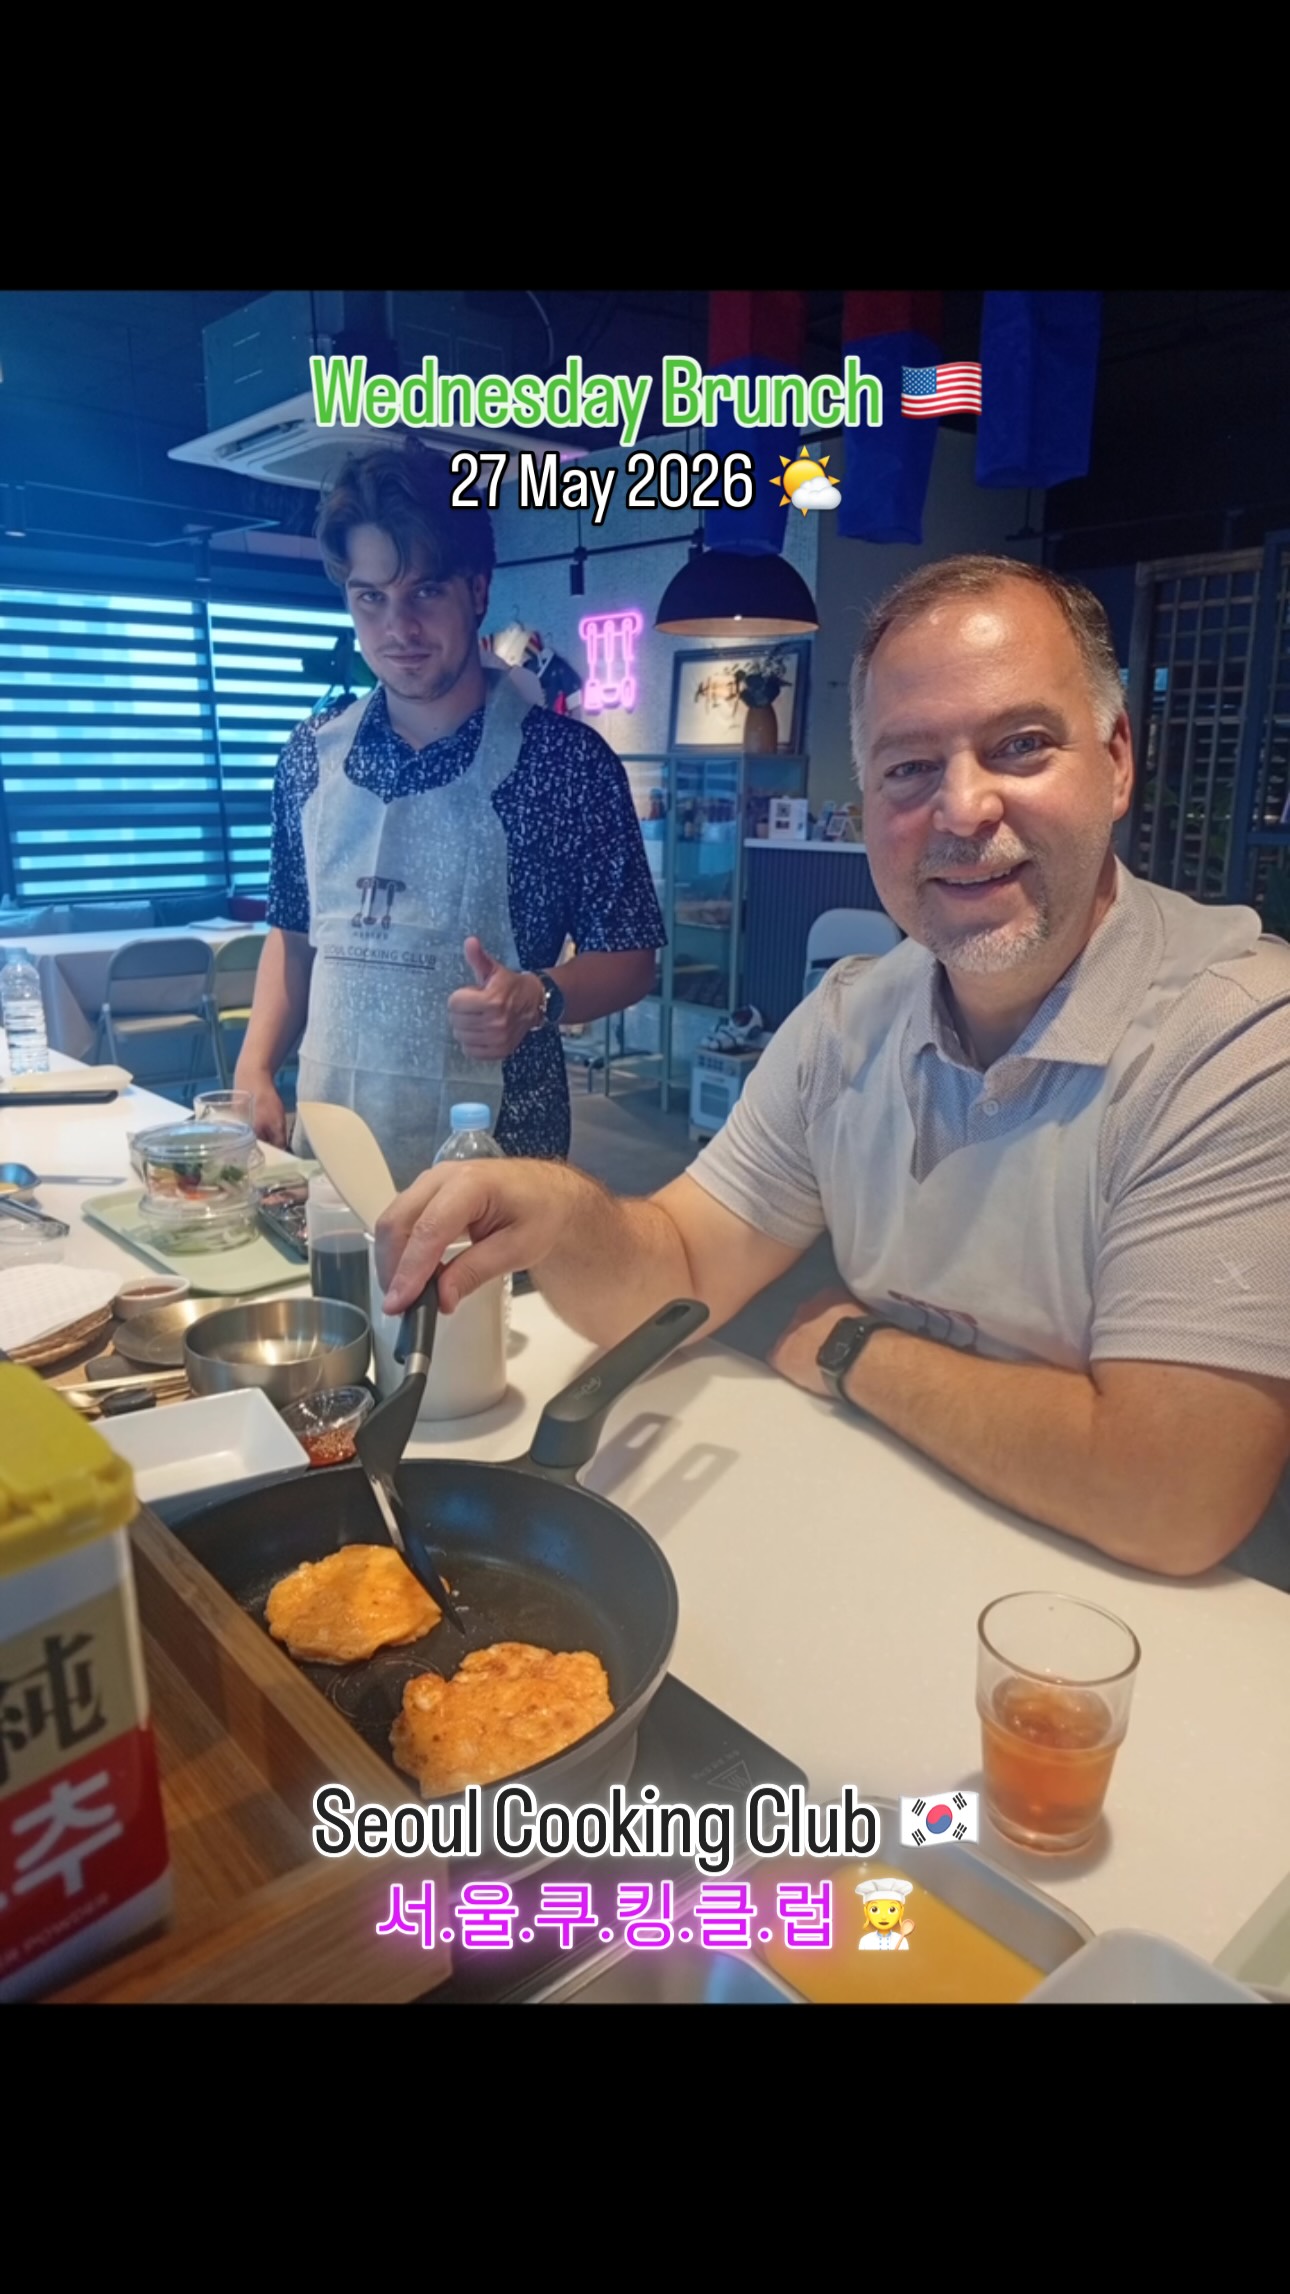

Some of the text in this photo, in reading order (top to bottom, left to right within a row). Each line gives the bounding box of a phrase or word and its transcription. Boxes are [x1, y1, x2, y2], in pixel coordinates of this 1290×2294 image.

[347, 946, 399, 960] COOKING
[401, 951, 437, 965] CLUB
[0, 1771, 124, 1909] 추
